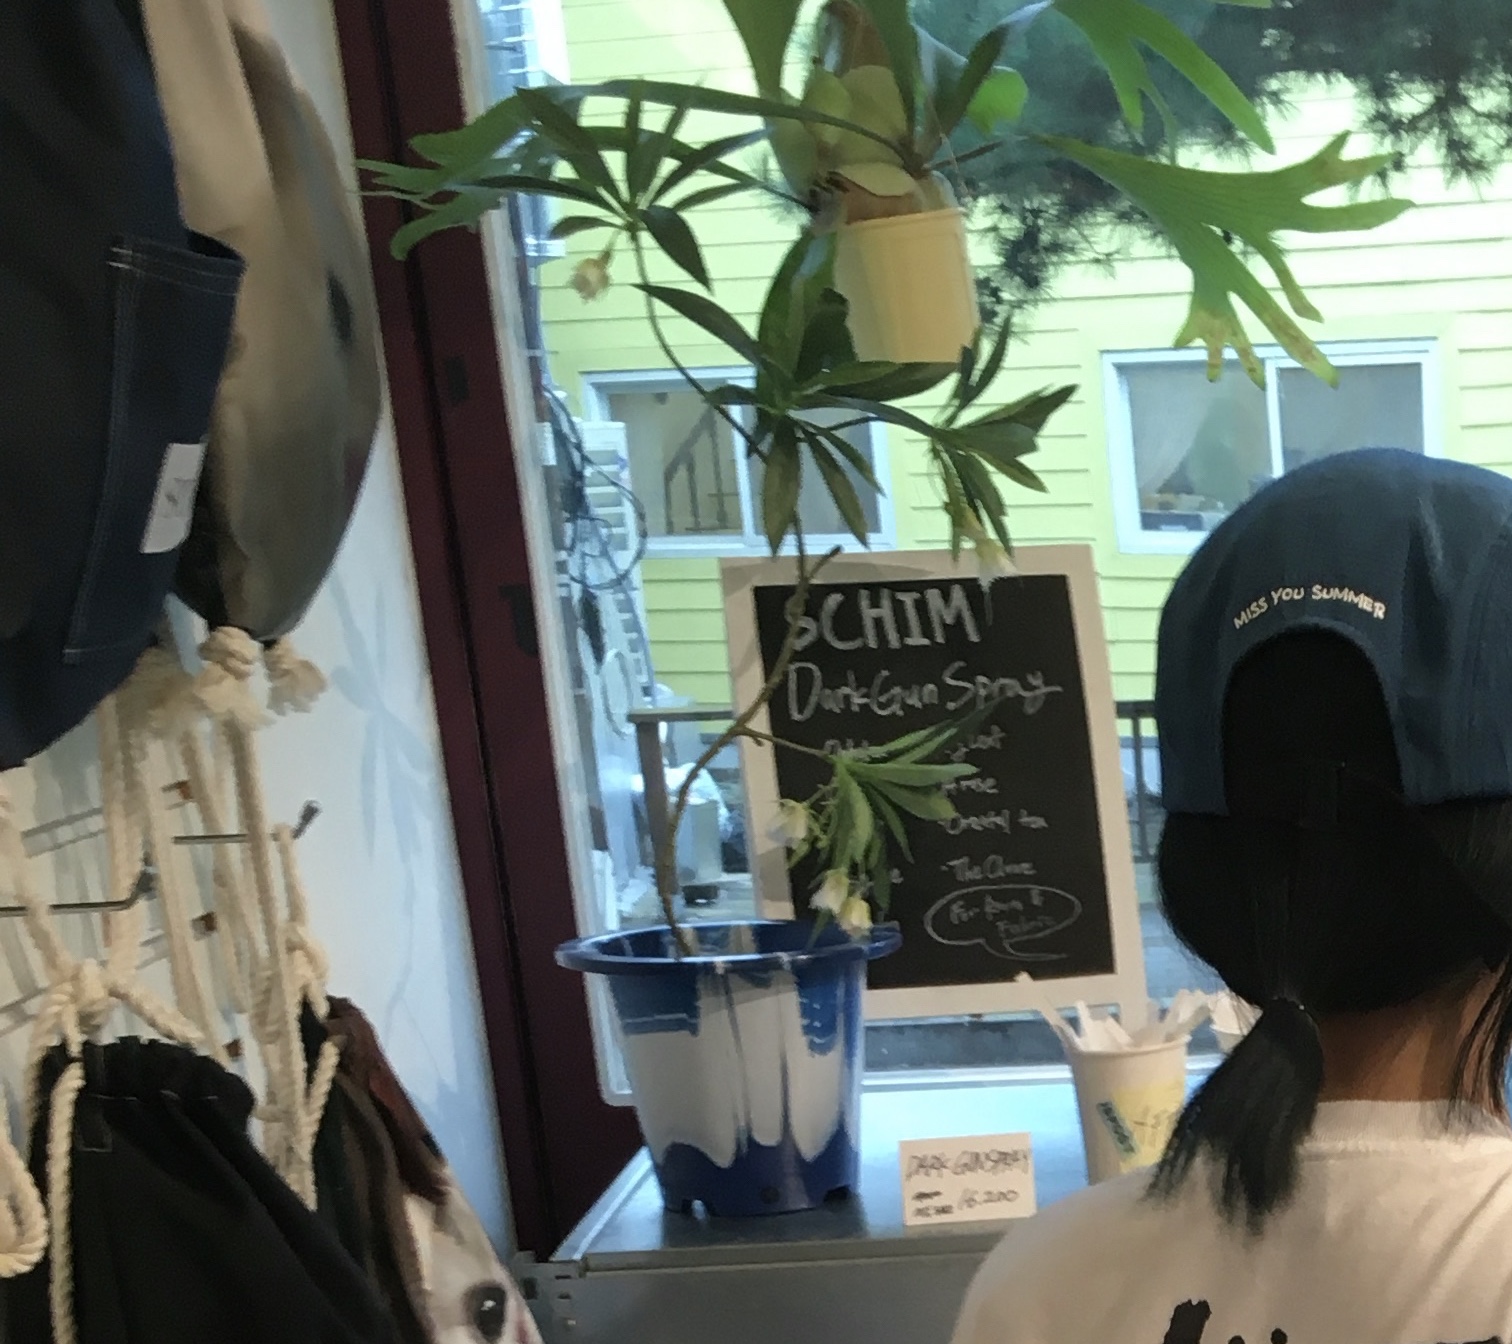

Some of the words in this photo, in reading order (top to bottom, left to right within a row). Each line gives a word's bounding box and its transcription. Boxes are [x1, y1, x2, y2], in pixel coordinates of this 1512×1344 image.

[784, 584, 982, 650] SCHIM
[1233, 596, 1269, 630] MISS
[1271, 586, 1305, 606] YOU
[1311, 584, 1387, 620] SUMMER
